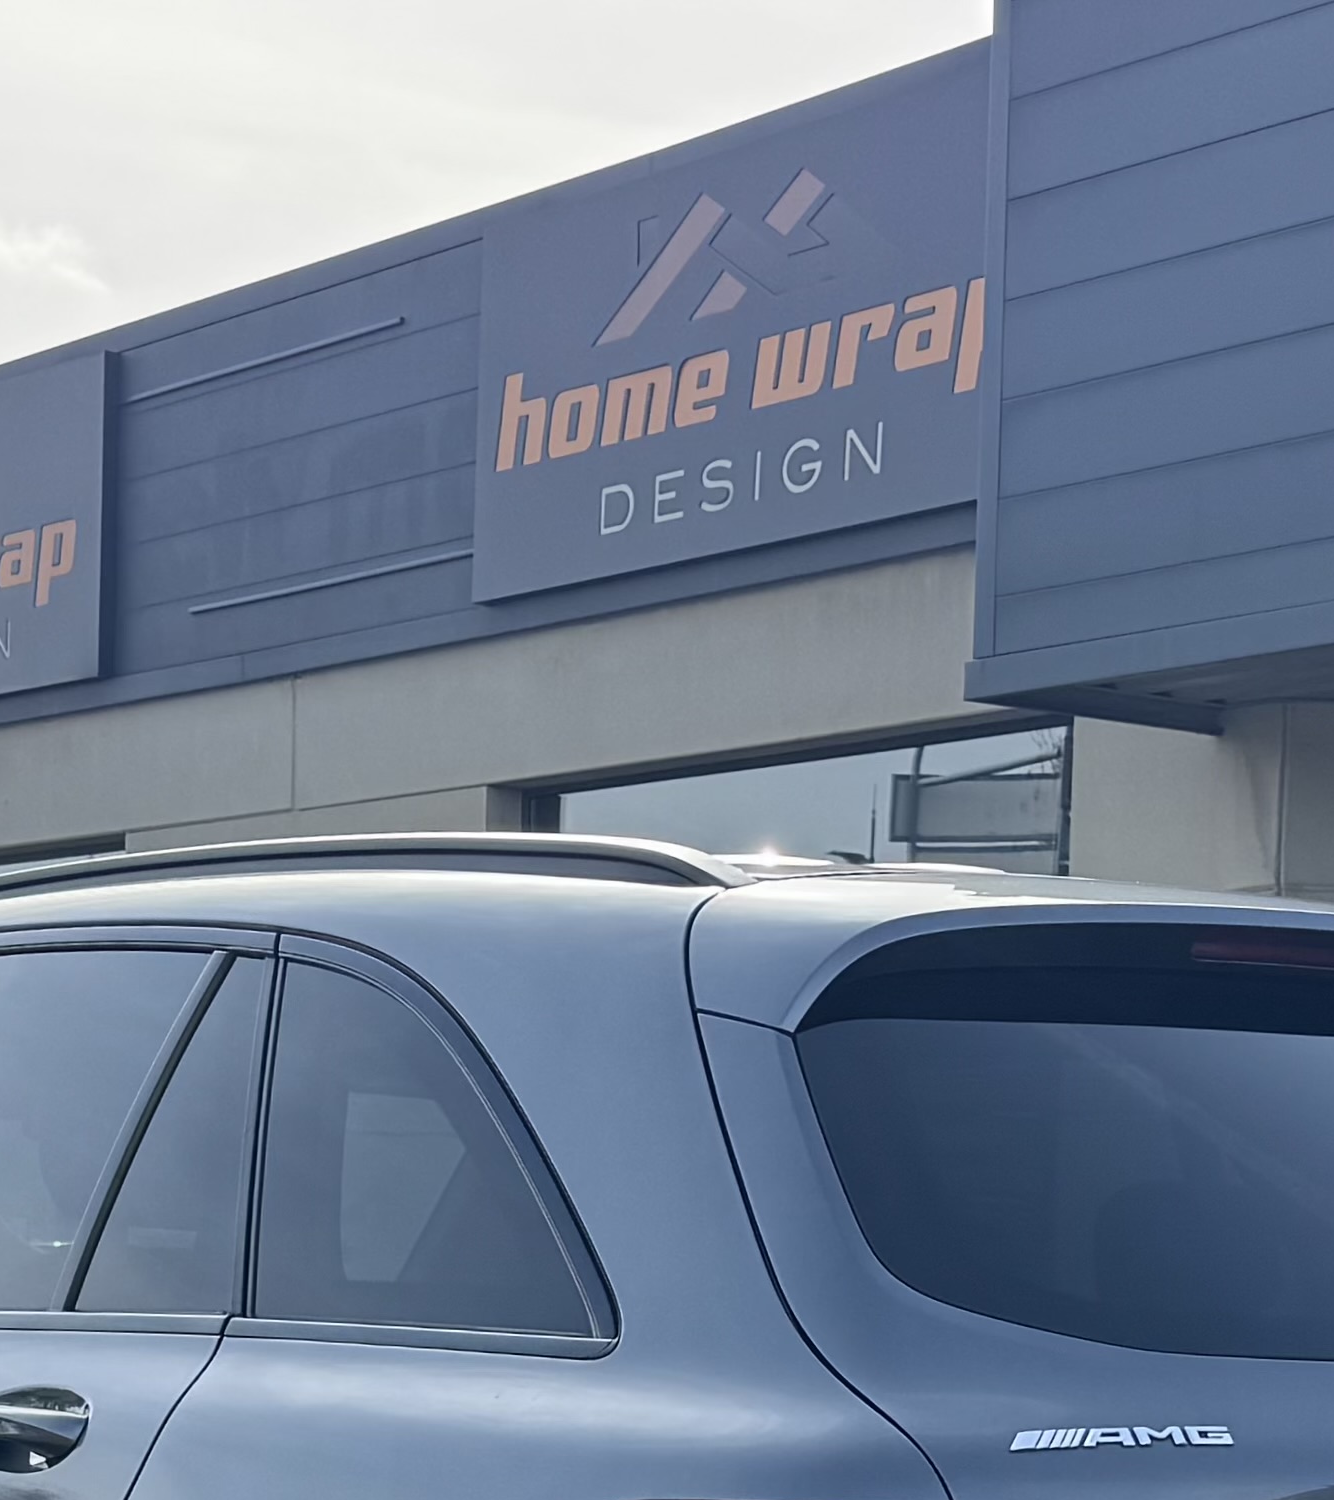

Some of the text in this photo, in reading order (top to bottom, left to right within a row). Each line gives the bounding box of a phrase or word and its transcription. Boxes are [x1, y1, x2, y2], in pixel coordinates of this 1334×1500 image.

[495, 349, 729, 472] home
[599, 421, 884, 536] DESIGN
[1085, 1425, 1235, 1448] AMG
